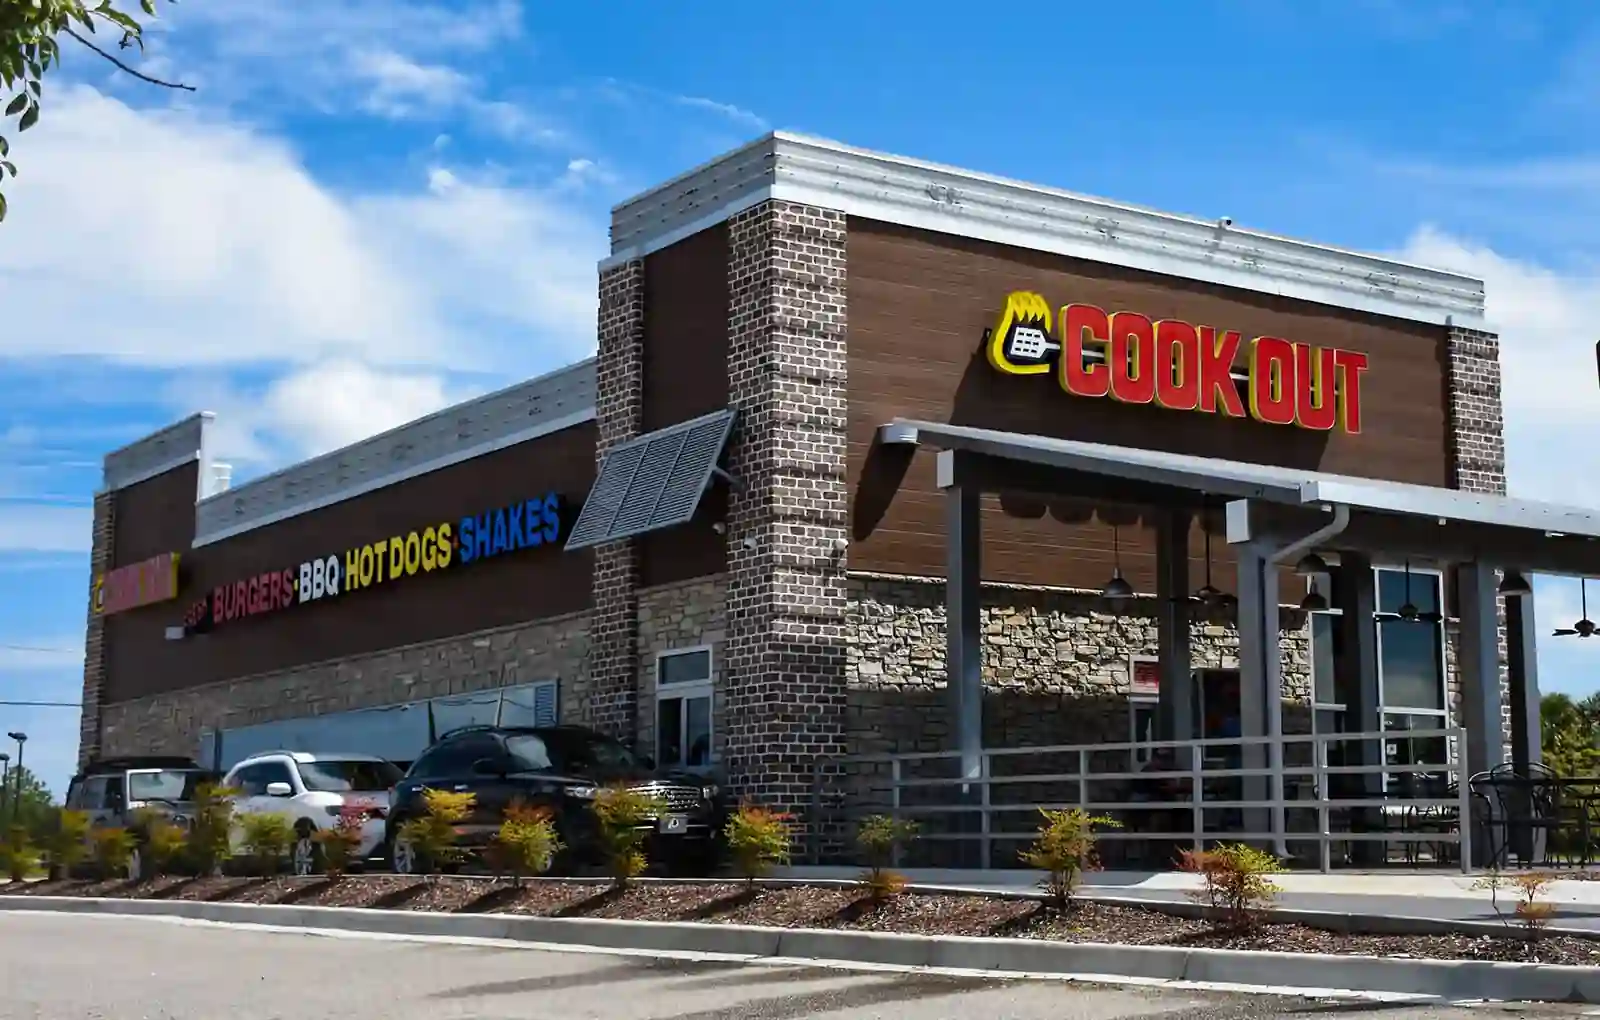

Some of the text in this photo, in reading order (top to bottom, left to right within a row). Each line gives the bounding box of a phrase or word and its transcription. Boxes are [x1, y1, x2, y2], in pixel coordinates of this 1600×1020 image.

[1059, 303, 1369, 434] COOK OUT
[212, 568, 294, 624] BURGERS
[300, 554, 340, 604] BBQ
[345, 541, 387, 591] HOT
[389, 523, 452, 580] DOGS
[459, 492, 560, 564] SHAKES
